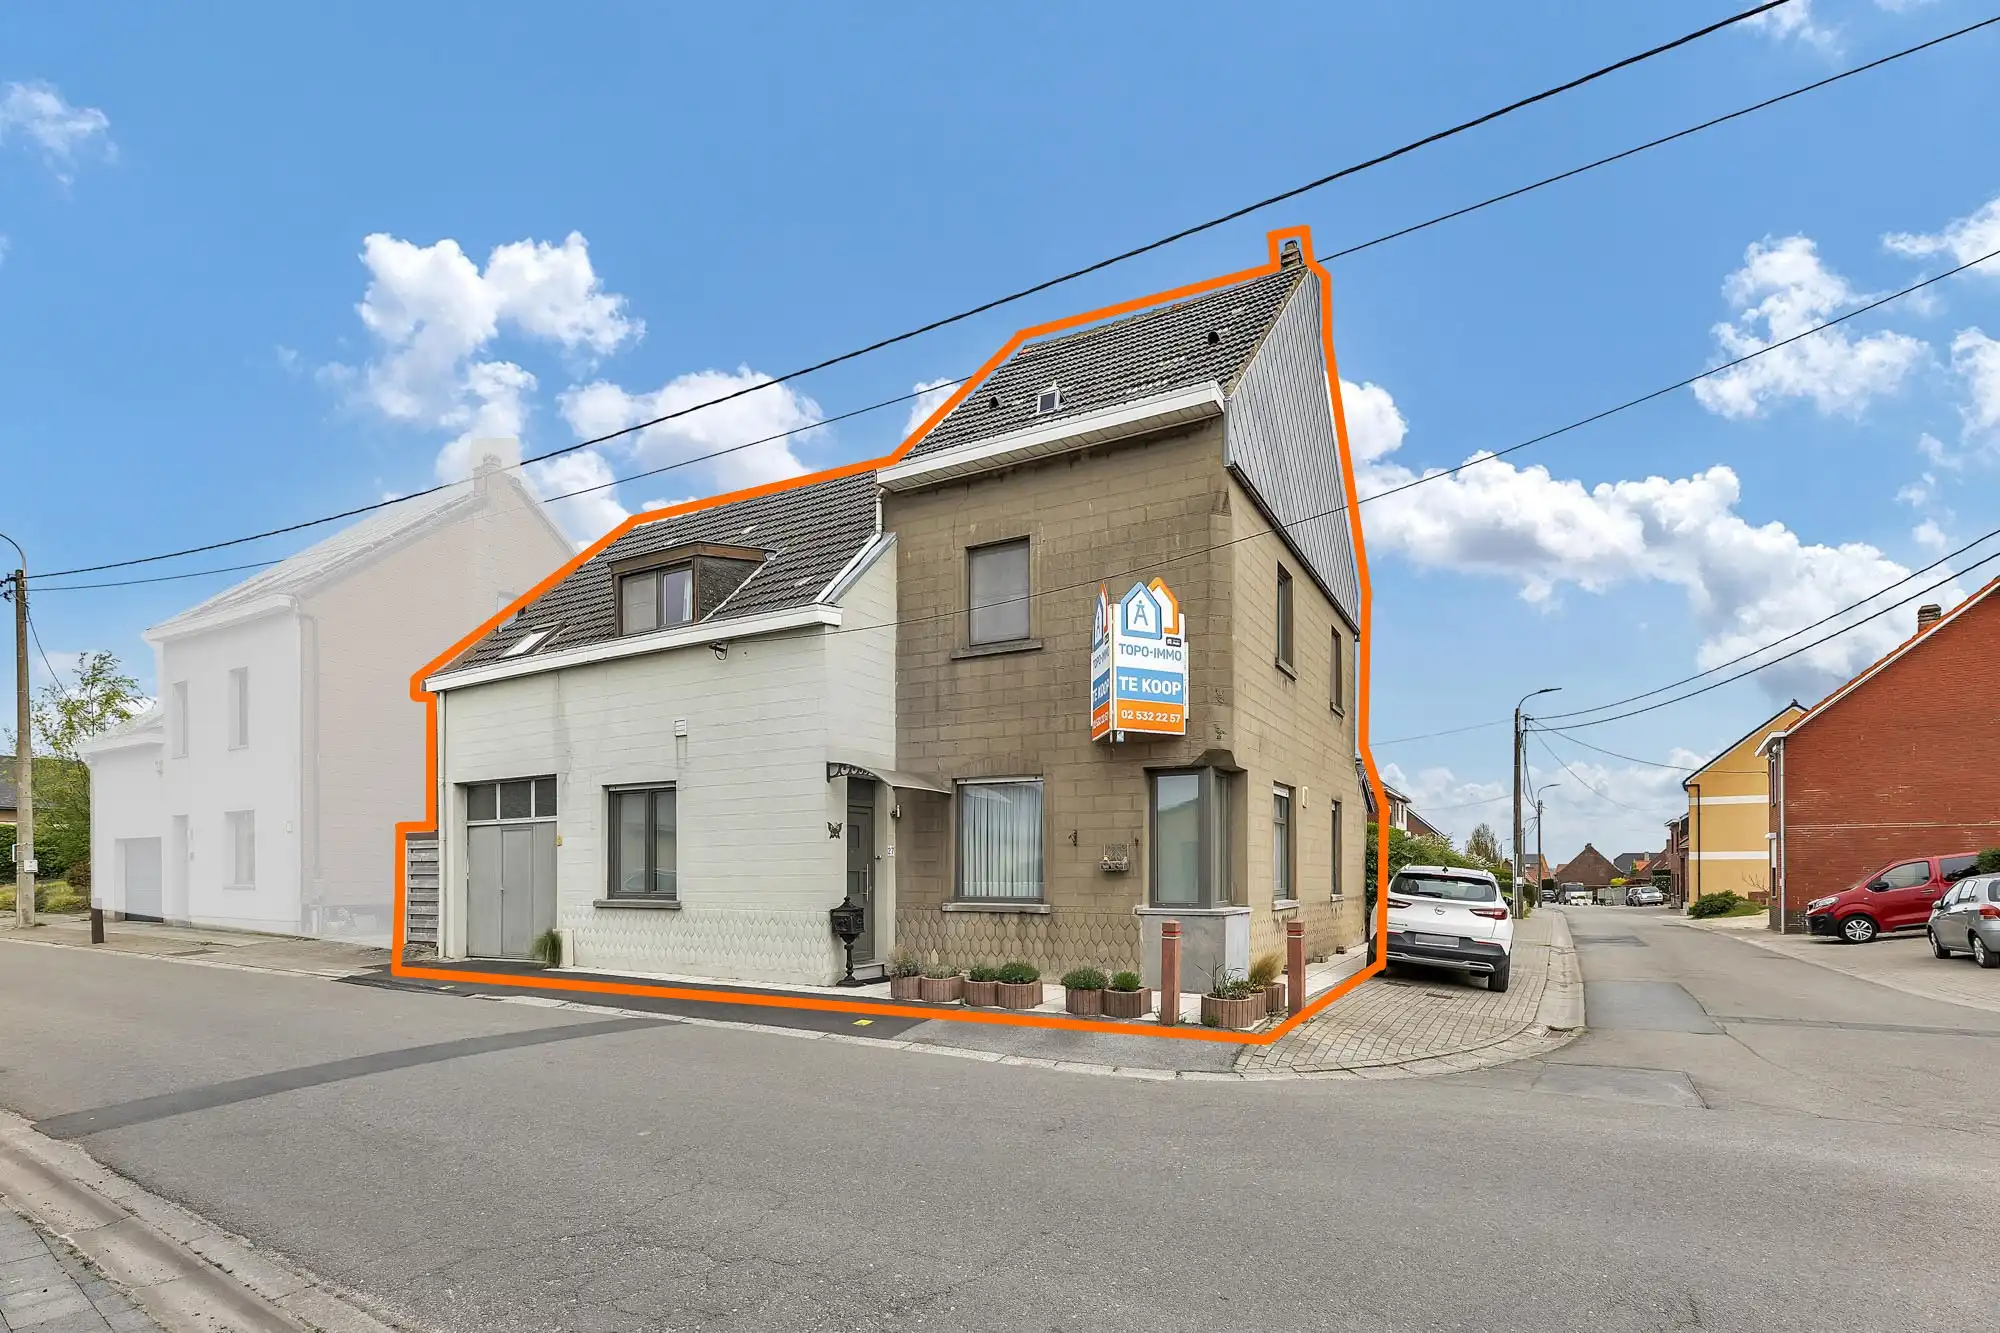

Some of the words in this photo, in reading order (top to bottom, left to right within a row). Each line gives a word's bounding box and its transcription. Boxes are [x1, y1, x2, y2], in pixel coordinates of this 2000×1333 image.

[1118, 643, 1182, 661] TOPO-IMMO
[1119, 676, 1138, 692] TE
[1142, 678, 1182, 696] KOOP
[1121, 709, 1134, 720] 02
[1135, 711, 1154, 721] 532
[1155, 712, 1168, 722] 22
[1169, 714, 1181, 723] 57
